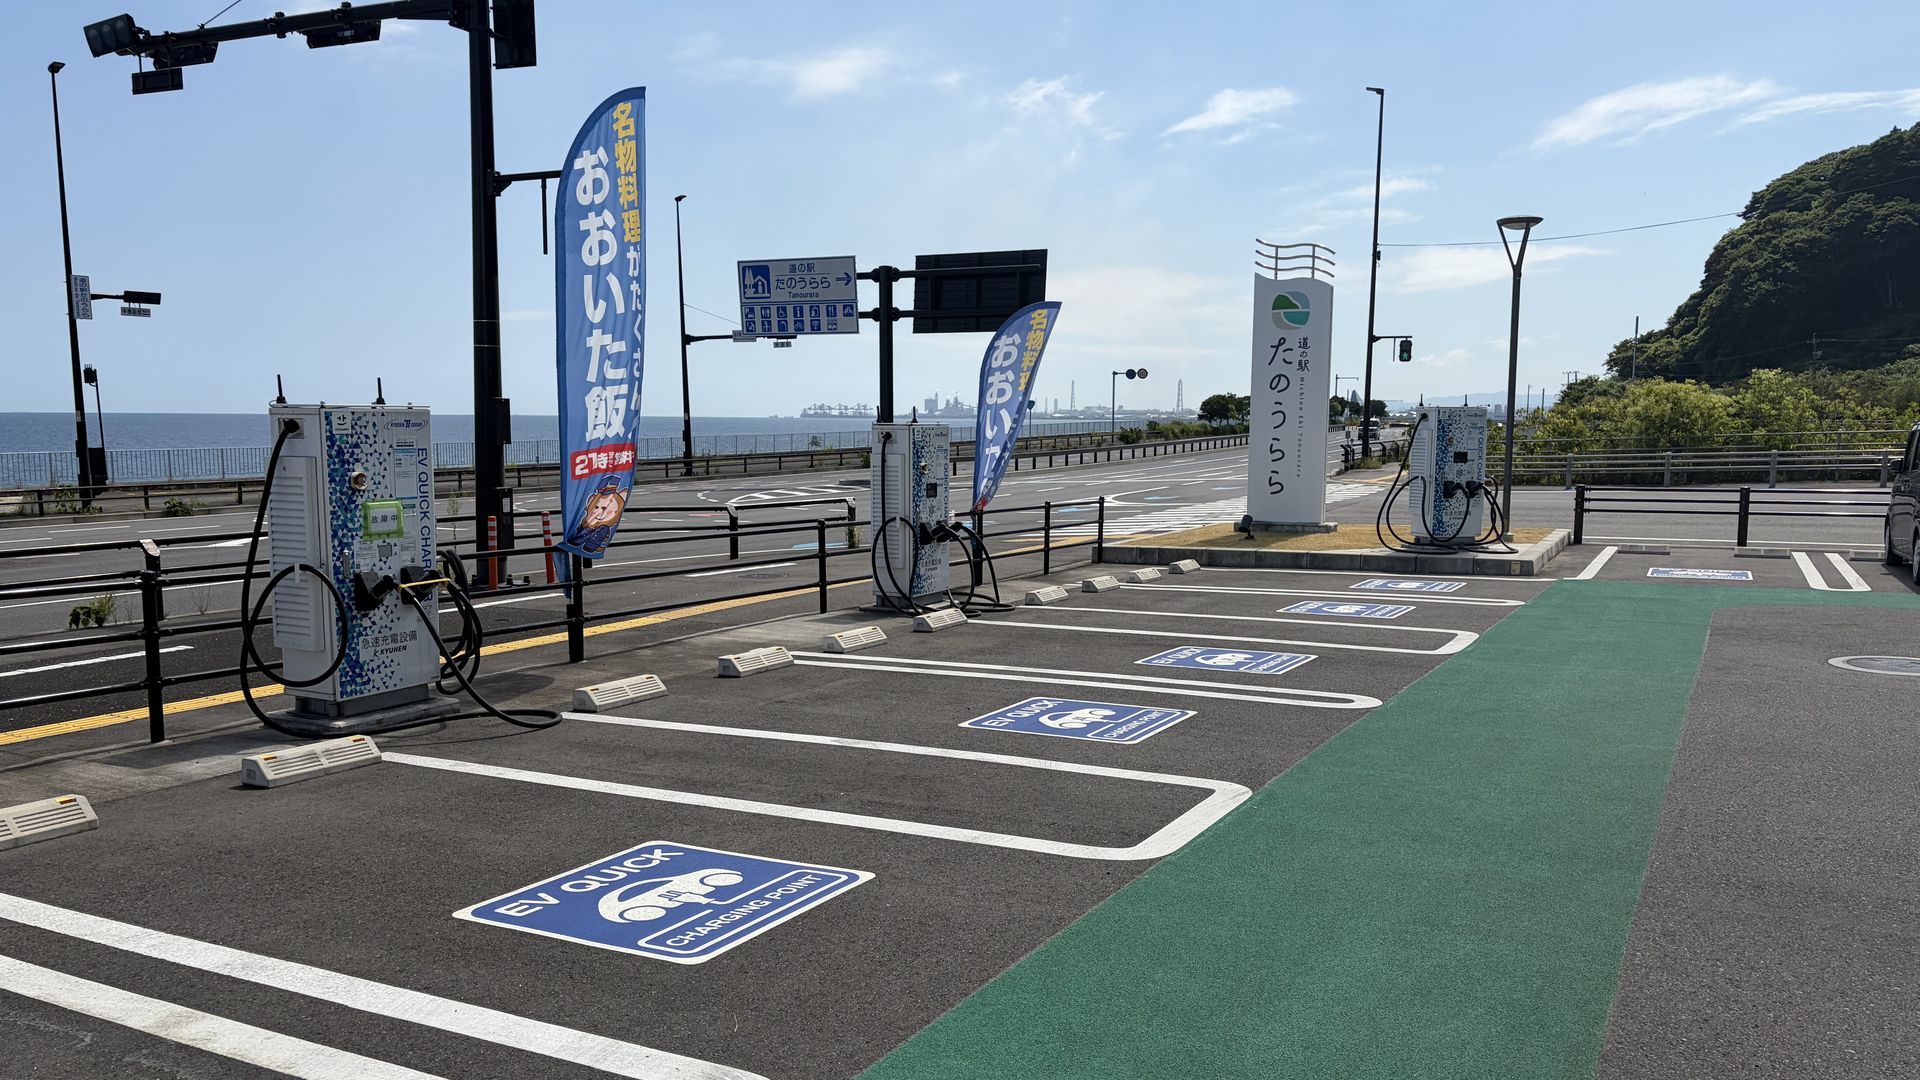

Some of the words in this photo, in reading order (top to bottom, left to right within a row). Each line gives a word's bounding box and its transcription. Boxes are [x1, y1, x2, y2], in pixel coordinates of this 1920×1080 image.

[788, 263, 816, 273] 道の駅
[573, 146, 628, 442] おおいた飯
[775, 276, 831, 290] たのうらら
[788, 291, 819, 299] Tanourara
[1296, 336, 1311, 372] 道の駅
[1268, 336, 1294, 495] たのうらら
[417, 448, 428, 467] EV
[417, 472, 431, 522] QUICK
[361, 630, 418, 650] 急速充電設備
[380, 644, 408, 655] KYUHEN
[981, 717, 1016, 727] EV
[1006, 699, 1064, 718] QUICK
[493, 892, 561, 918] EV
[560, 848, 685, 894] QUICK
[665, 896, 771, 947] CHARGING
[767, 873, 824, 901] POINT
